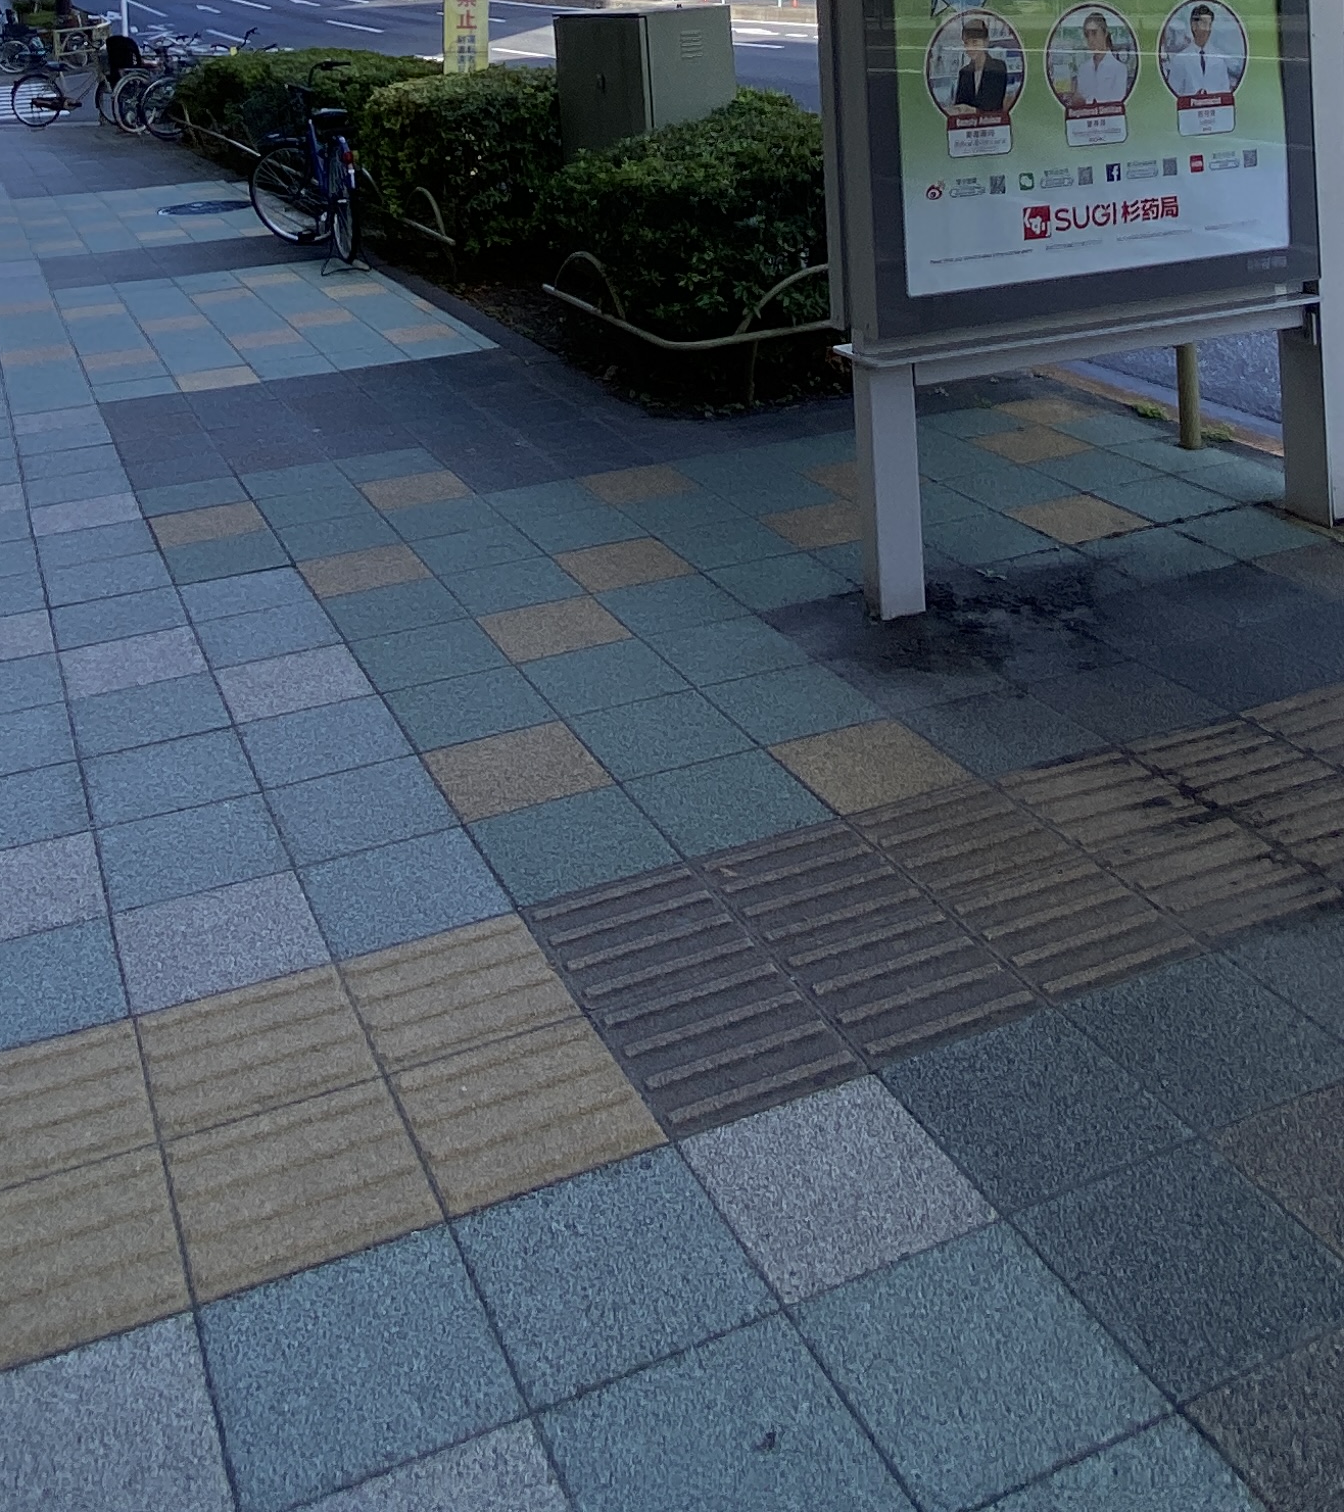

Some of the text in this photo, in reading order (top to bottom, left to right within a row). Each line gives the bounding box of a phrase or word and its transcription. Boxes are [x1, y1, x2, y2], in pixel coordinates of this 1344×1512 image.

[1054, 195, 1180, 232] SUGI 杉药局
